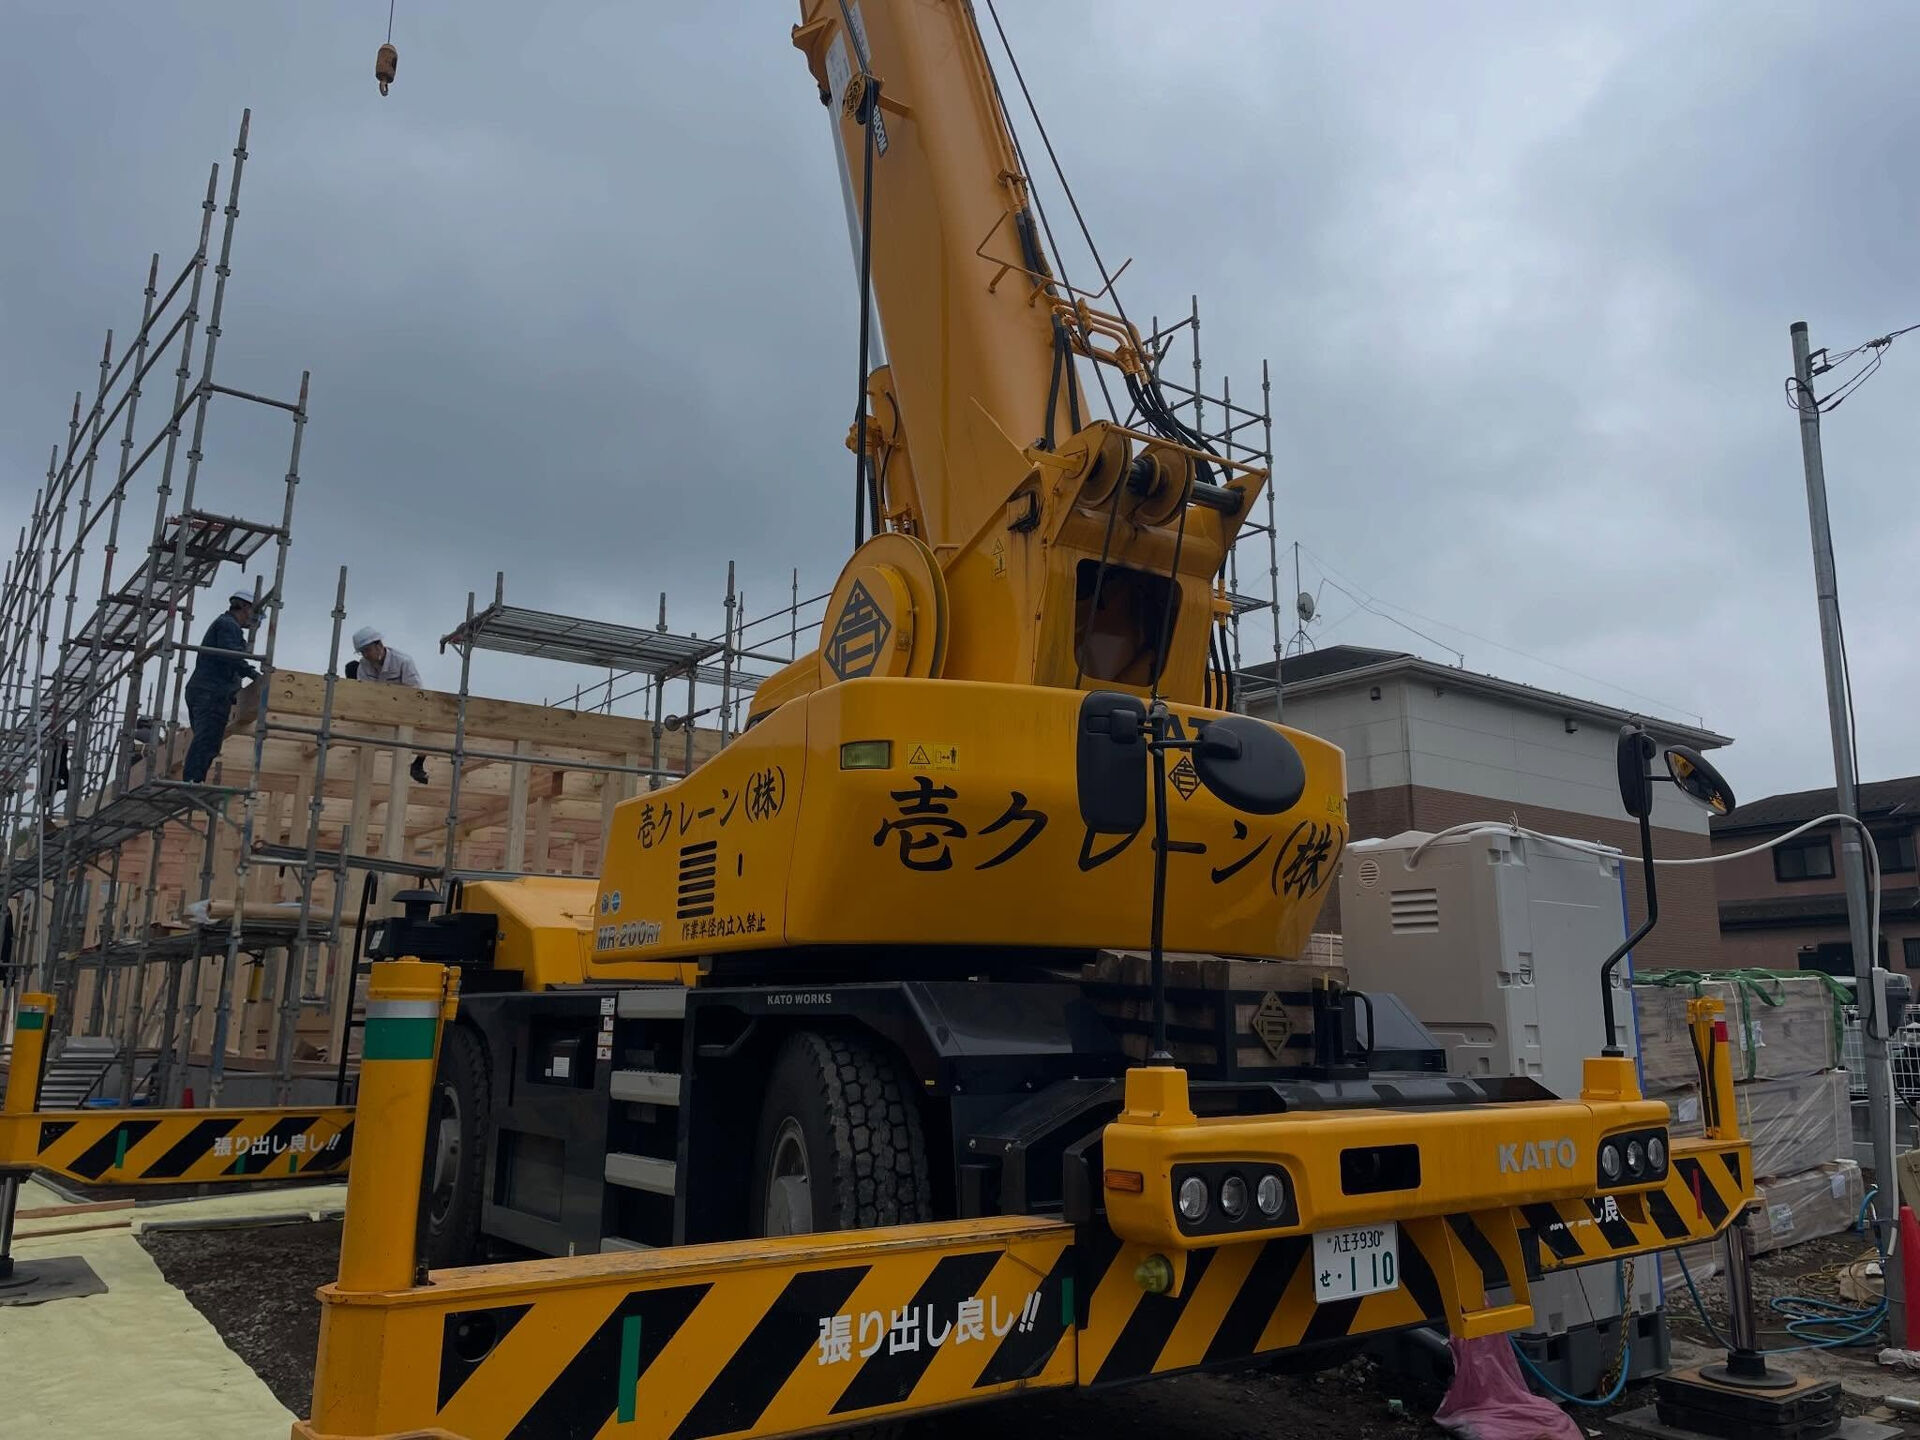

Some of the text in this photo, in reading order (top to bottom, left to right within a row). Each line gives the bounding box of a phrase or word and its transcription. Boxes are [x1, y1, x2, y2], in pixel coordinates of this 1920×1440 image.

[682, 912, 766, 941] 作業半径内立入禁止
[767, 993, 832, 1005] KATO WORKS
[1497, 1136, 1577, 1174] KATO
[1333, 1230, 1381, 1254] 八王子930
